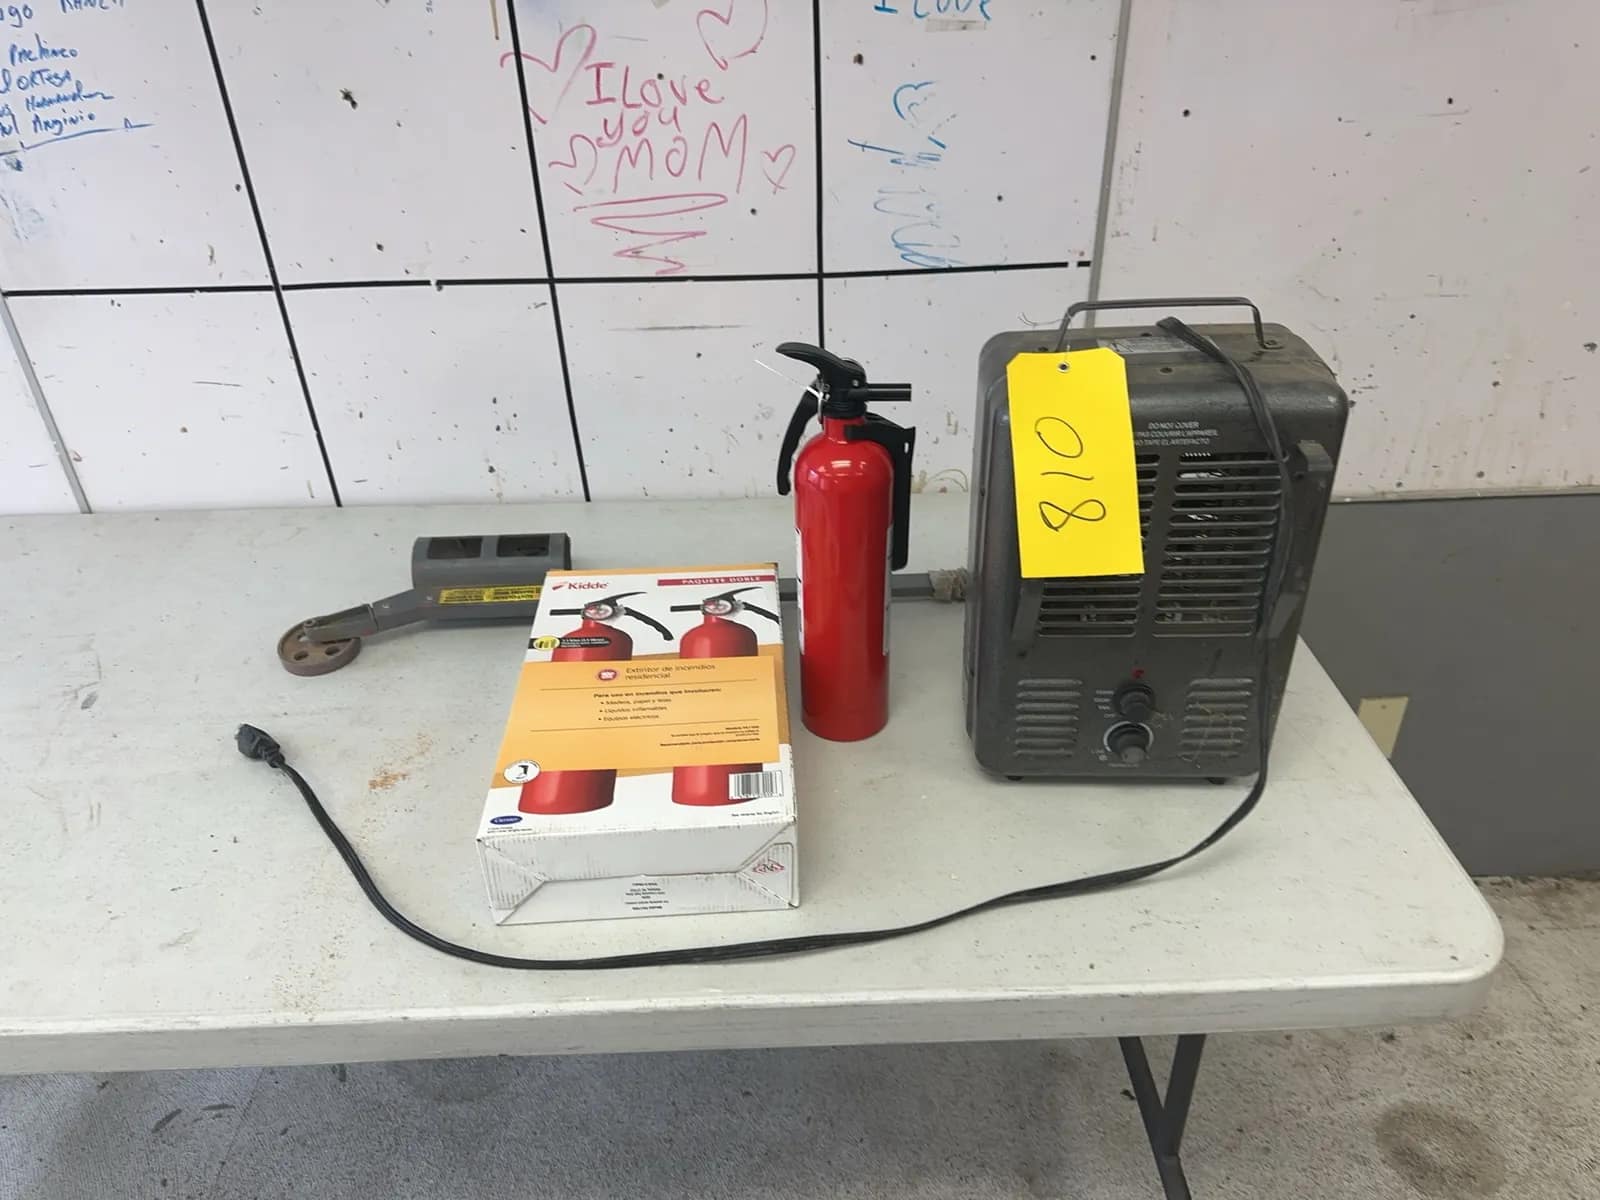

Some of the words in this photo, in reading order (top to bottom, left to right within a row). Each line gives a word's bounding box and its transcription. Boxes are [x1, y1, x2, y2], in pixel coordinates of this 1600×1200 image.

[596, 106, 682, 148] you
[612, 113, 748, 194] MOM
[1035, 416, 1107, 532] 810
[568, 581, 608, 590] Kidde
